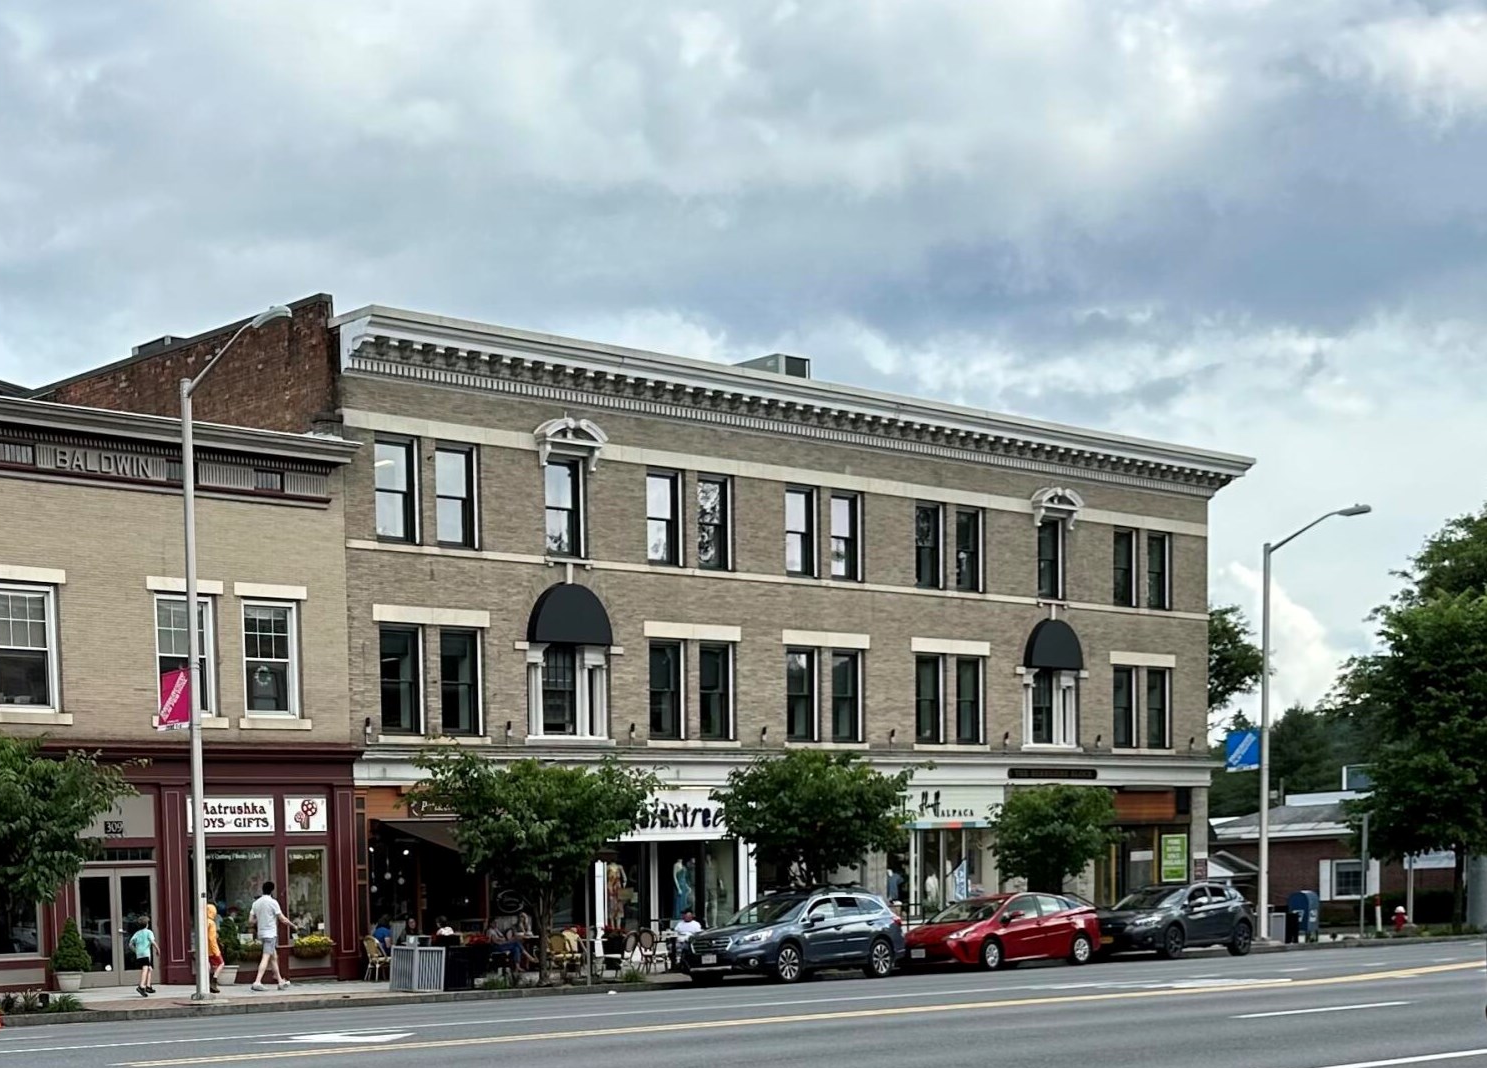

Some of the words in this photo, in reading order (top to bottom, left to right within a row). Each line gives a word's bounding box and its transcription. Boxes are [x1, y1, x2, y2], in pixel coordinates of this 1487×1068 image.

[55, 448, 152, 479] BALDWIN
[941, 808, 974, 818] ALPACA
[106, 822, 123, 833] 309
[203, 817, 226, 829] OYS
[234, 817, 270, 829] GIFTS
